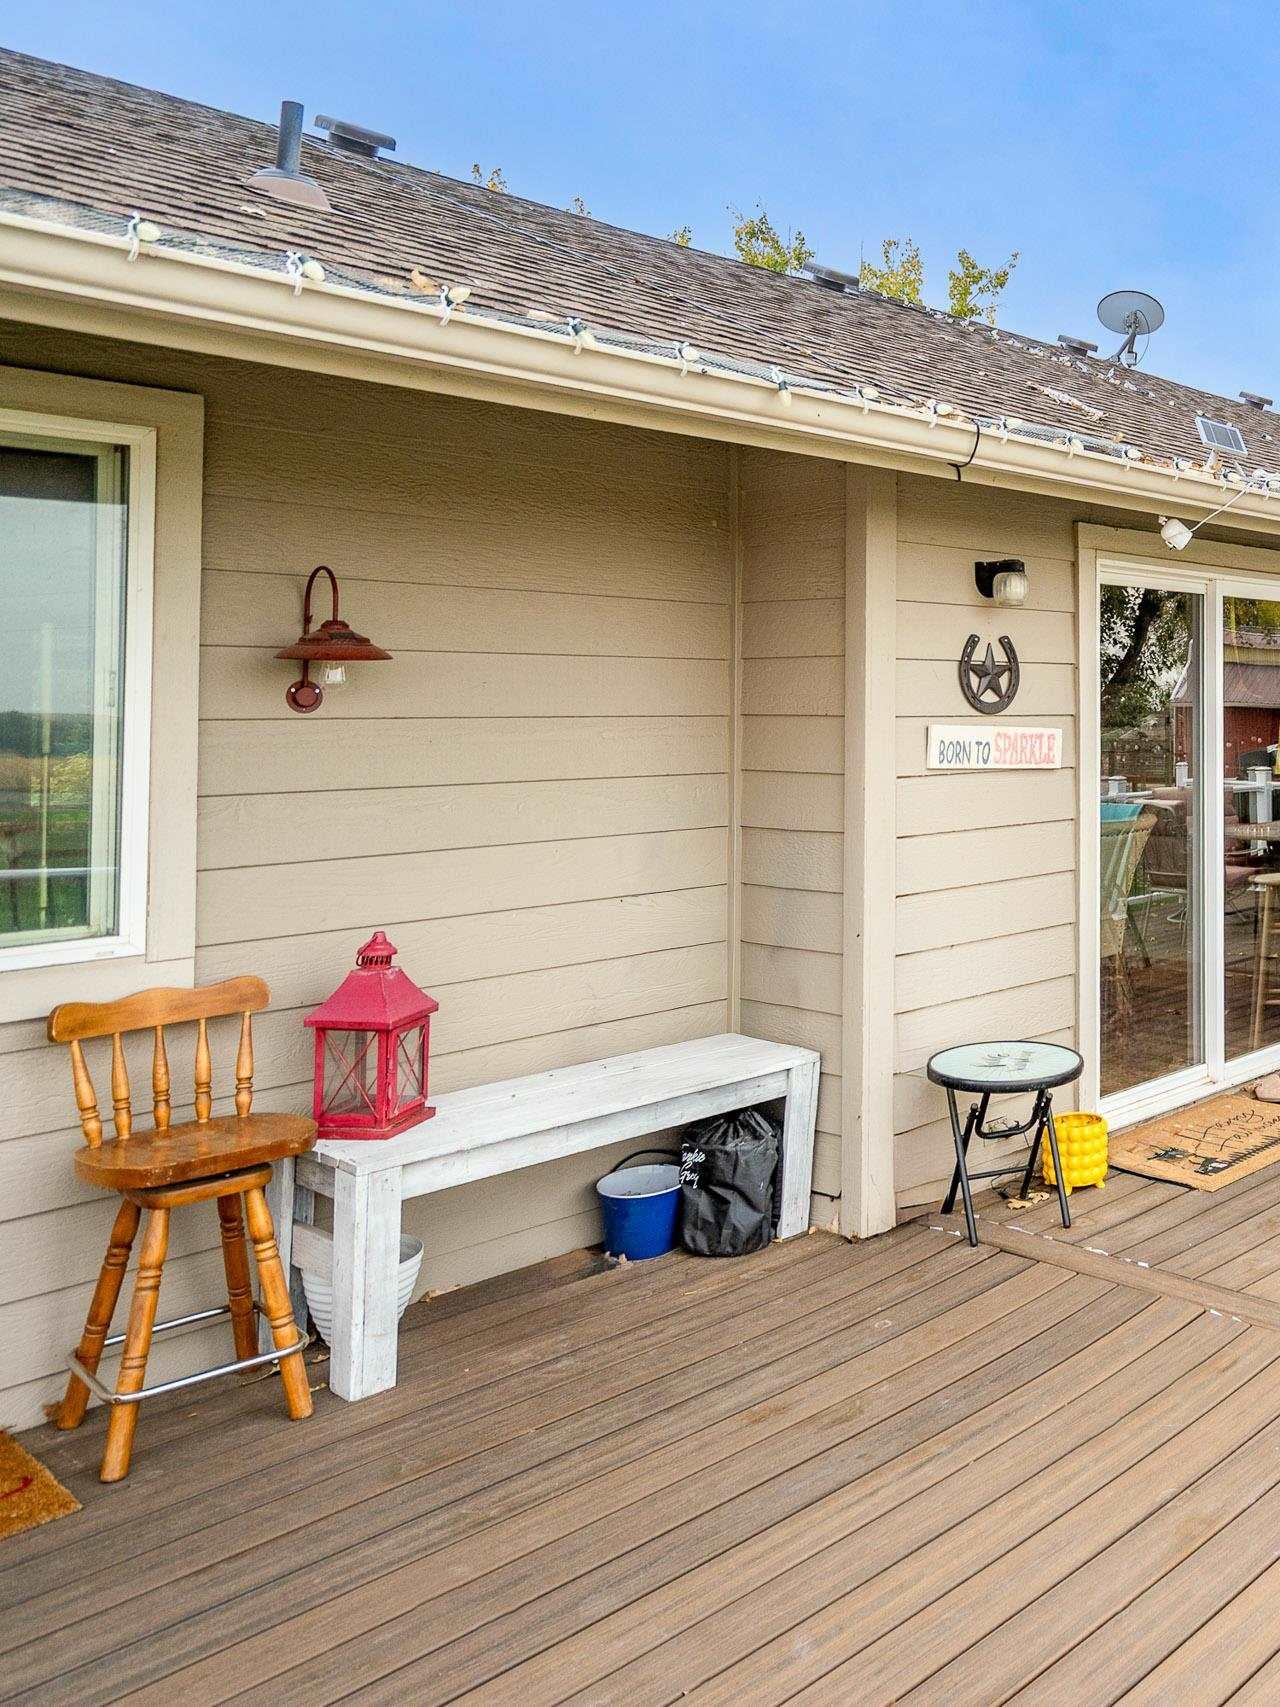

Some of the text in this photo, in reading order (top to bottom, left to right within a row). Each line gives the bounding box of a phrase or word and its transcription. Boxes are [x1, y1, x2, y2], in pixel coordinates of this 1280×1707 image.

[938, 732, 1056, 765] BORN TO SPARKLE
